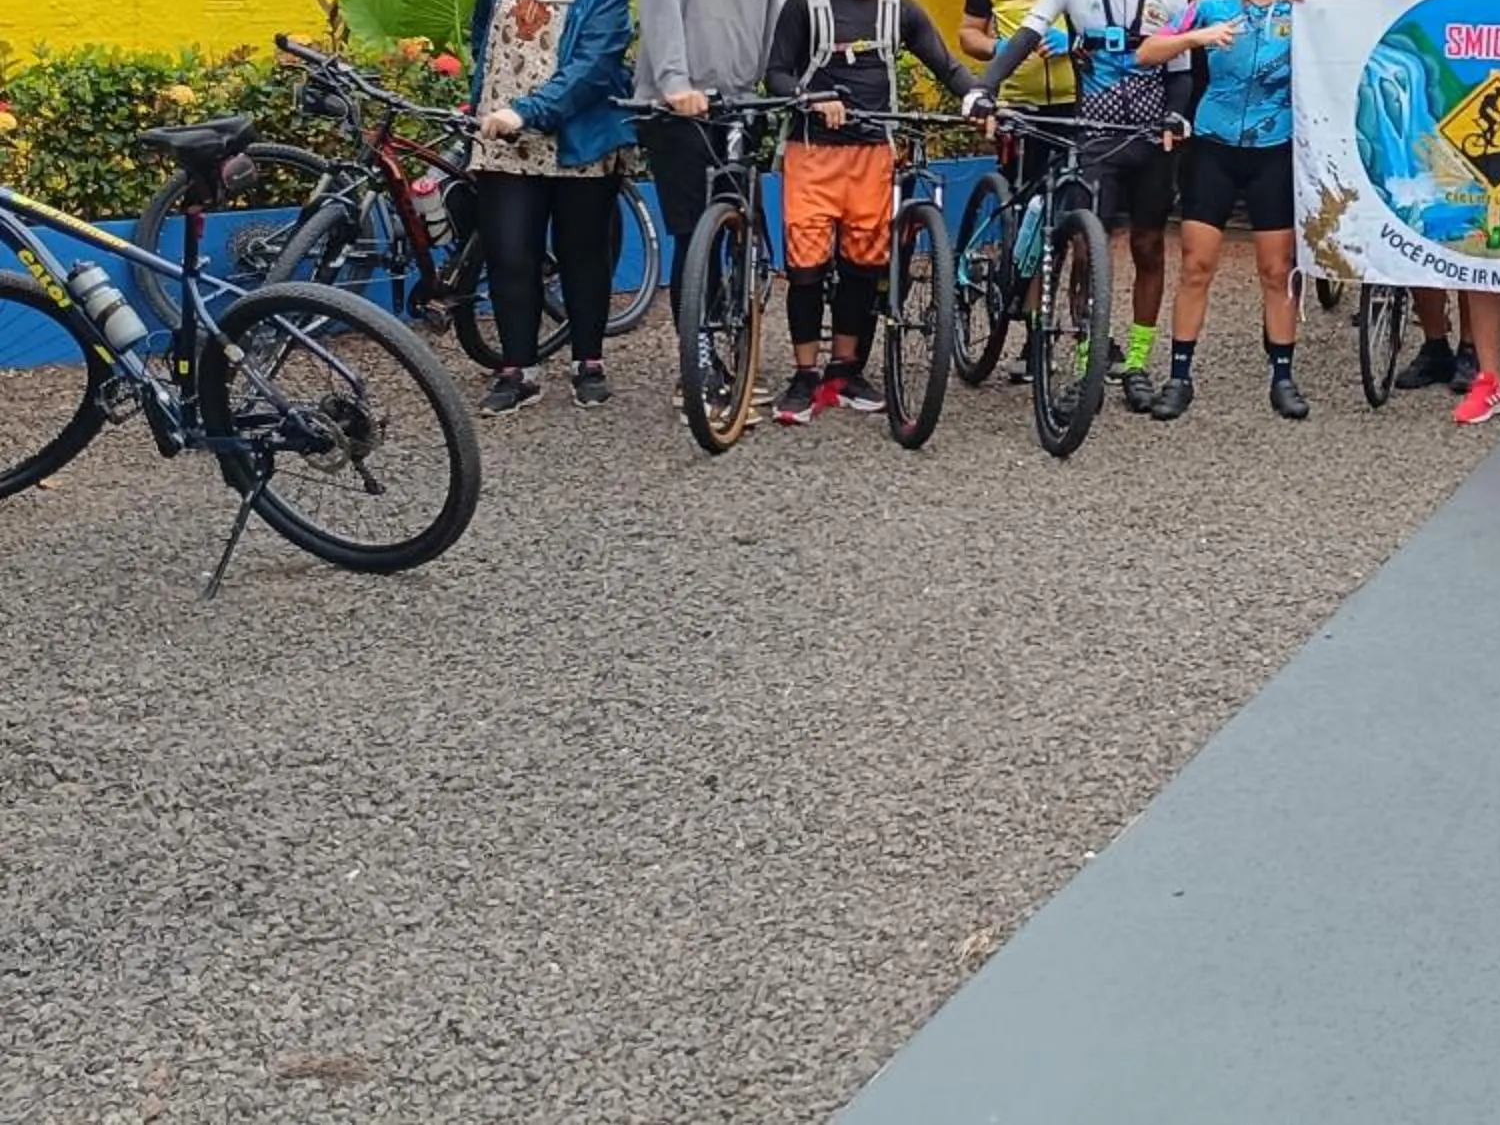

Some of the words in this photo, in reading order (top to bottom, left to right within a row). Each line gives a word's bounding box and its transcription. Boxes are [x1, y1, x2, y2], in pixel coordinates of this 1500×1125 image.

[17, 250, 71, 308] CALOI
[1380, 223, 1424, 263] VOCÊ
[1422, 252, 1469, 283] PODE
[1471, 268, 1487, 284] IR
